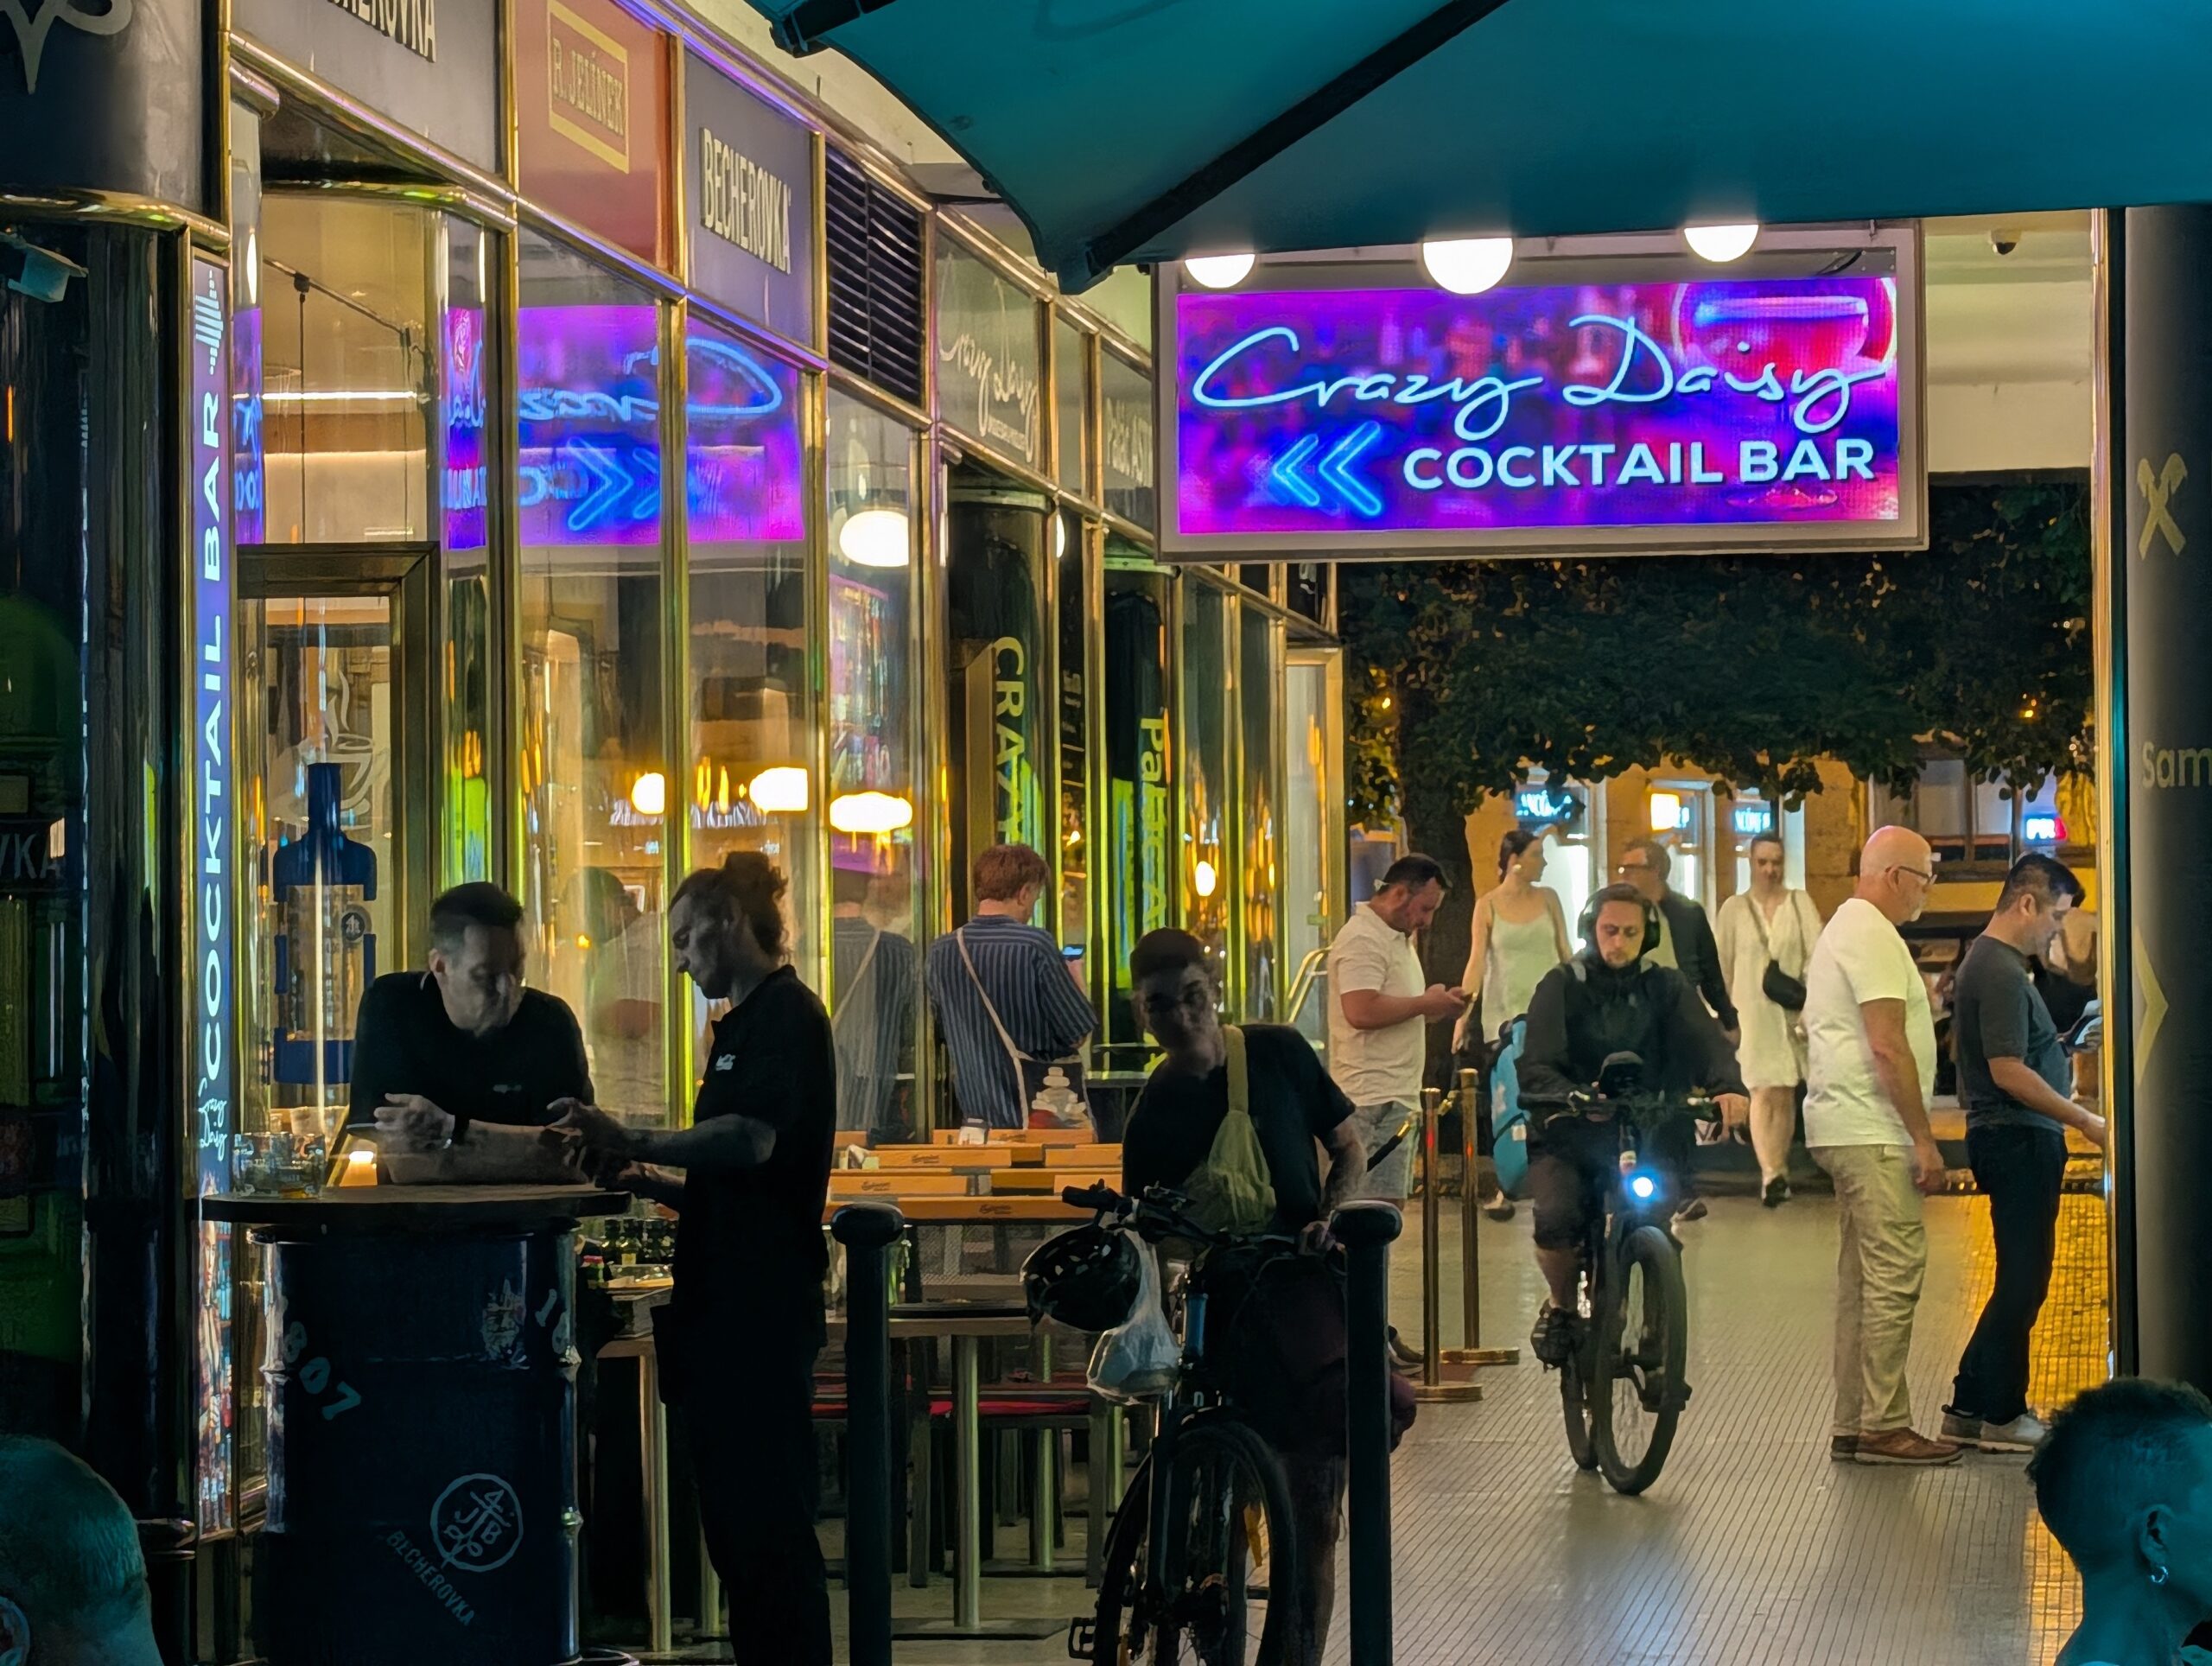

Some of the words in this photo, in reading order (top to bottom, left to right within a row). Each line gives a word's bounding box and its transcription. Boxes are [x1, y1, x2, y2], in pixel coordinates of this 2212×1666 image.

[1192, 326, 1545, 442] Crazy
[1563, 315, 1894, 434] Daisy
[202, 391, 221, 581] BAR
[1403, 442, 1724, 491] COCKTAIL
[1738, 437, 1877, 485] BAR
[2142, 741, 2212, 789] Sam
[203, 615, 222, 1080] COCKTAIL
[386, 1529, 475, 1627] BECHEROVKA
